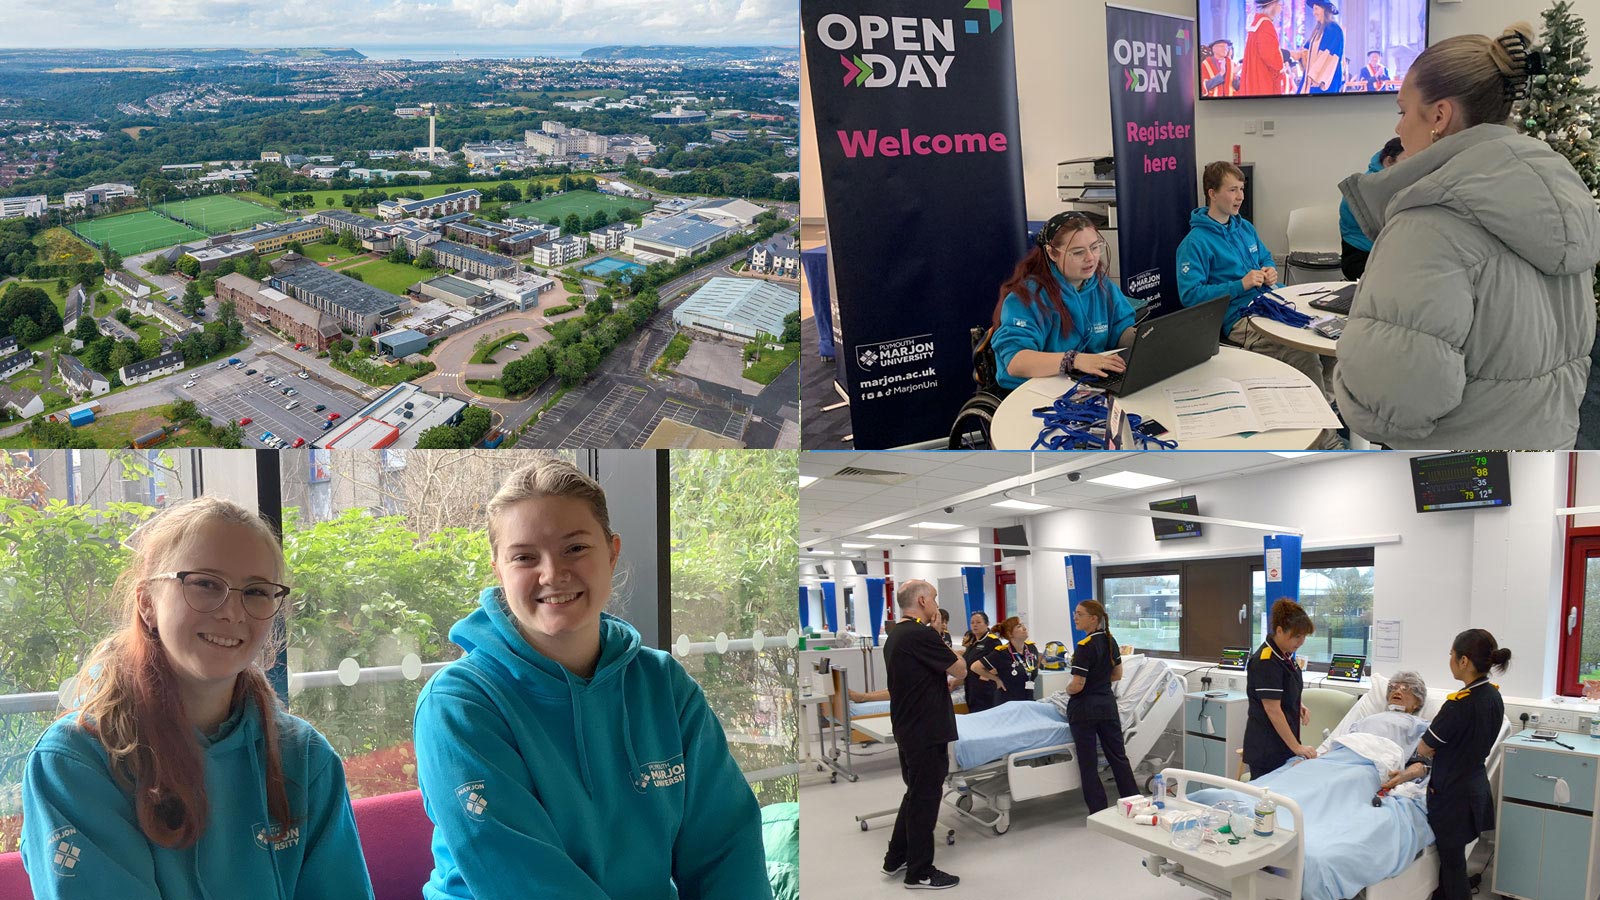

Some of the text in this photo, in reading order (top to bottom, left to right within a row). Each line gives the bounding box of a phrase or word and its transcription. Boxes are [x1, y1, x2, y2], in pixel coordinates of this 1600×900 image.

[816, 13, 956, 52] OPEN
[1113, 38, 1172, 68] OPEN
[864, 54, 954, 88] DAY
[1135, 70, 1172, 94] DAY
[1126, 121, 1191, 146] Register
[837, 128, 1008, 158] Welcome
[1144, 154, 1178, 174] here
[1136, 274, 1160, 287] MARJON
[880, 340, 914, 350] PLYMOUTH
[880, 342, 934, 360] MARJON
[880, 352, 934, 366] UNIVERSITY
[860, 367, 936, 388] marjon.ac.uk
[894, 380, 938, 394] MarjonUni
[1476, 456, 1487, 466] 79
[1476, 468, 1488, 477] 98
[1478, 478, 1487, 486] 35
[1465, 492, 1474, 500] 79
[1479, 490, 1488, 498] 12
[458, 784, 484, 796] MARJON
[274, 838, 300, 850] RSITY
